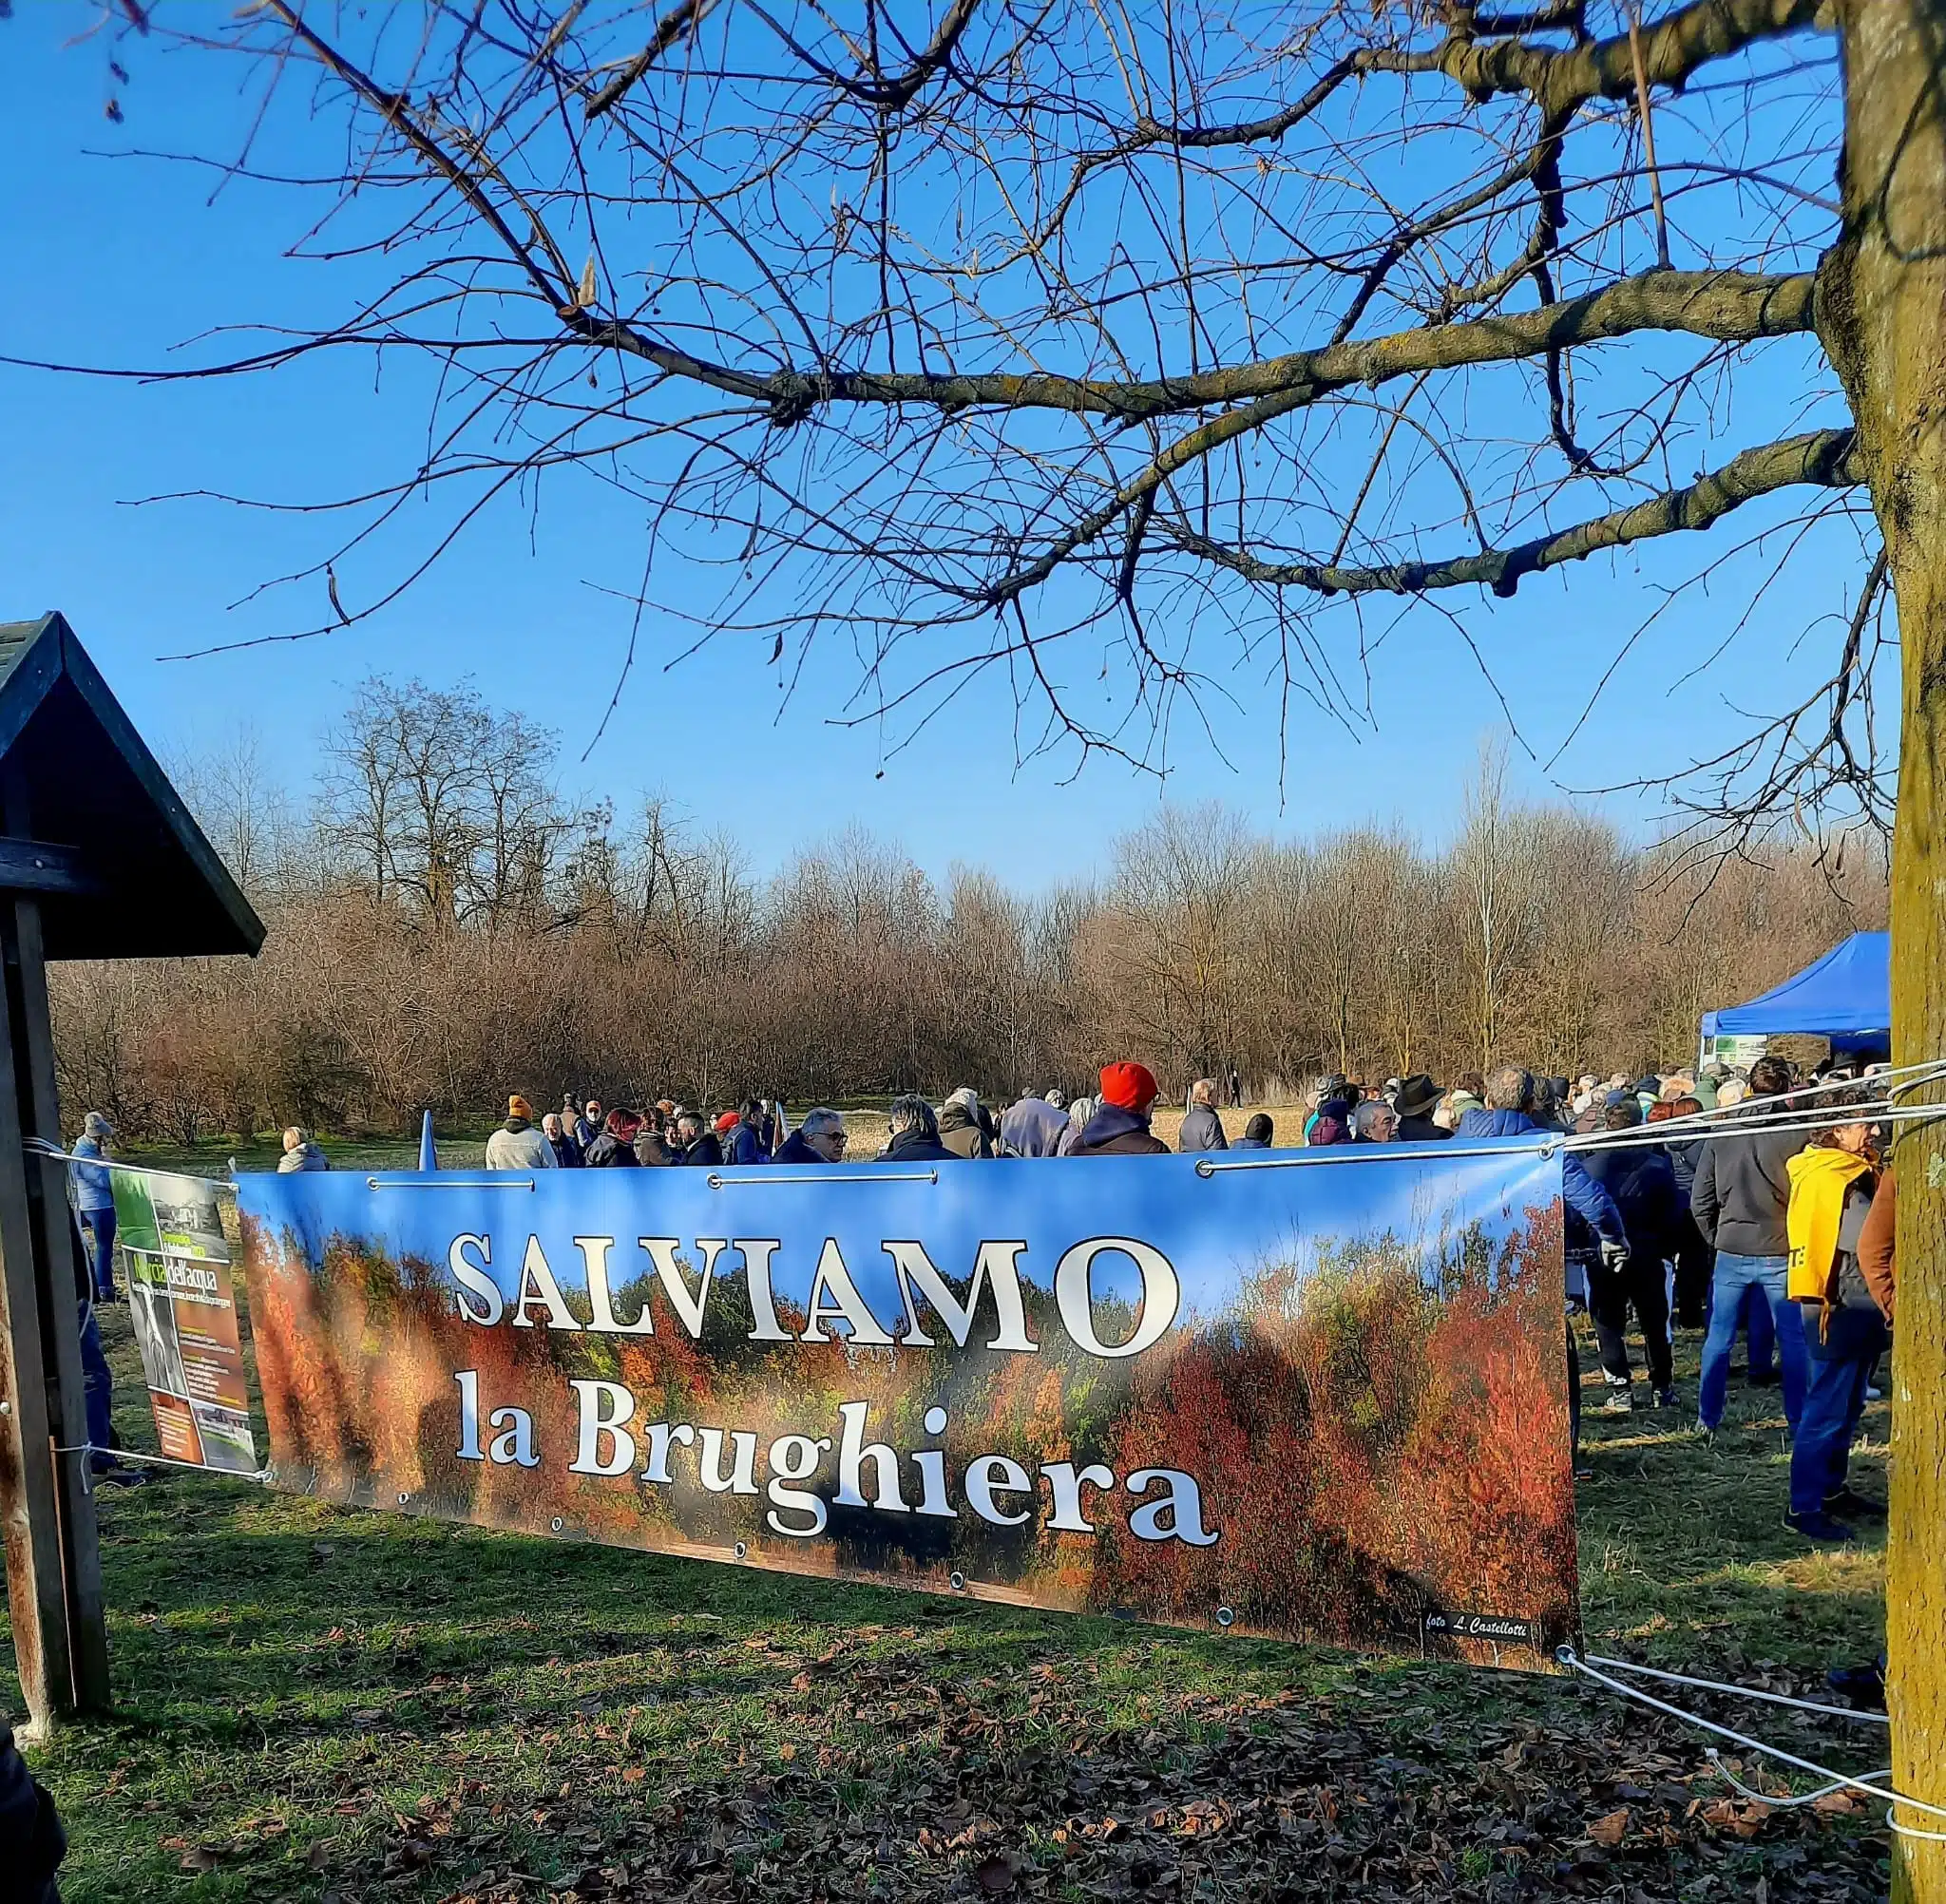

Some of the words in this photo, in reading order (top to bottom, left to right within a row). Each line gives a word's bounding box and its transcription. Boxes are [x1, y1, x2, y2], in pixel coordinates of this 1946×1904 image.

[448, 1232, 1179, 1359] SALVIAMO
[454, 1369, 541, 1469] la
[567, 1379, 1221, 1548] Brughiera
[1426, 1612, 1445, 1629] foto
[1453, 1615, 1468, 1630] L.
[1469, 1617, 1526, 1637] Castellotti
